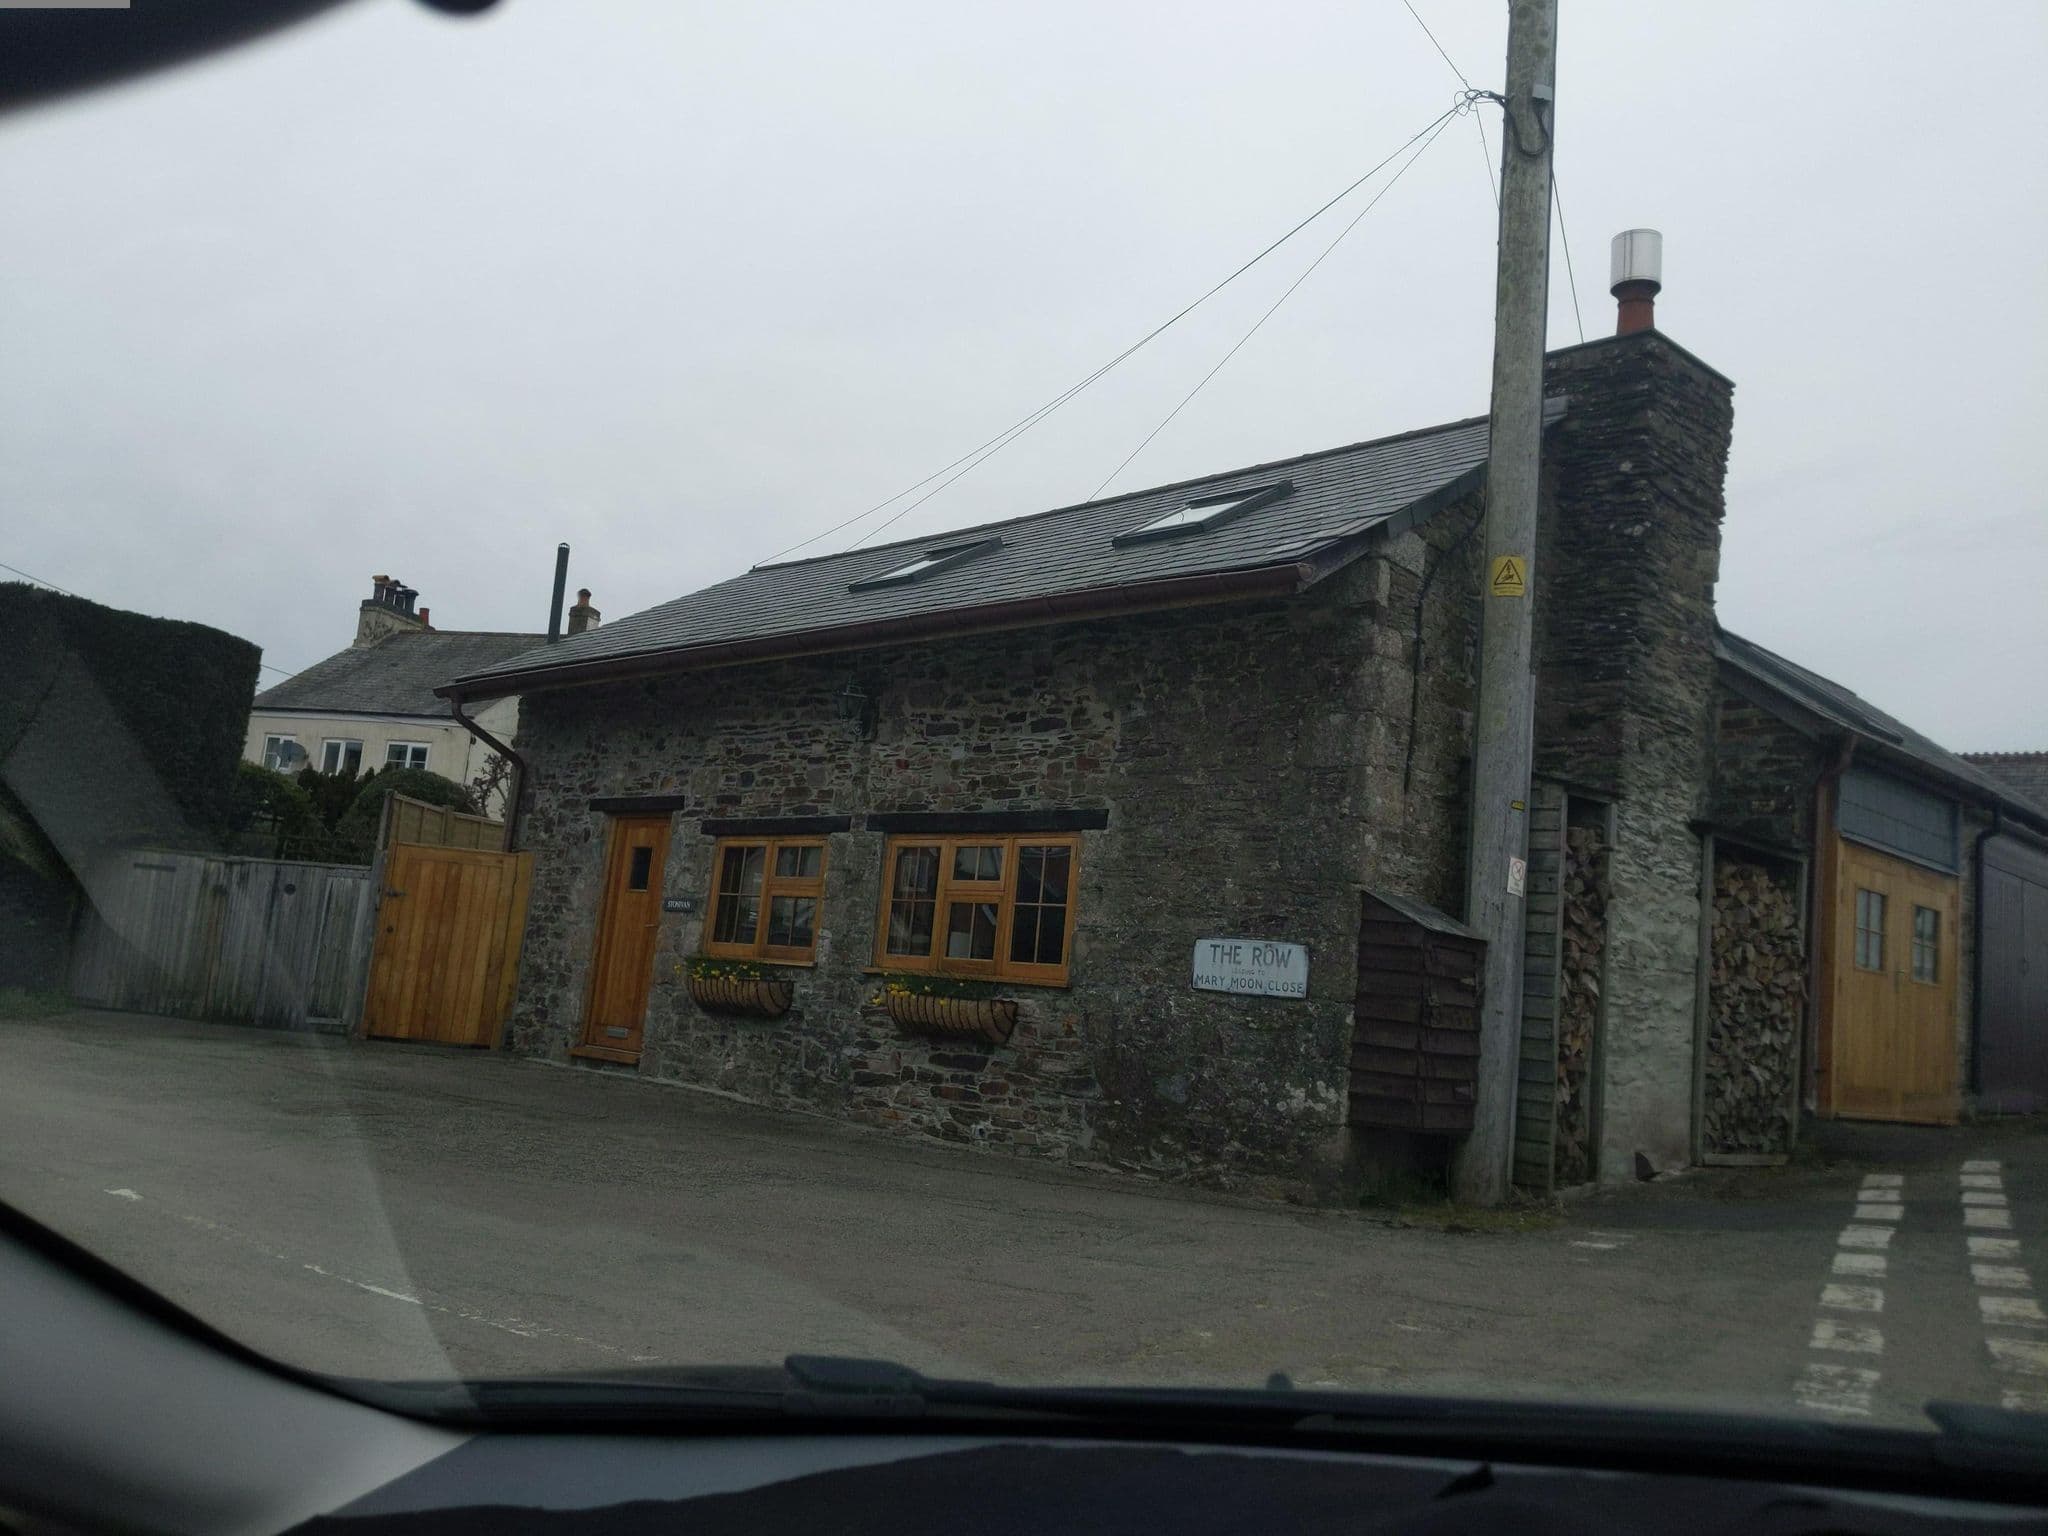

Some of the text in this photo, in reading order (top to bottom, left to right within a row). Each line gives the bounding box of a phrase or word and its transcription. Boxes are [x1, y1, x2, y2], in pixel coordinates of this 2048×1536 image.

[1210, 944, 1242, 965] THE
[1196, 974, 1304, 994] MARY MOON CLOSE
